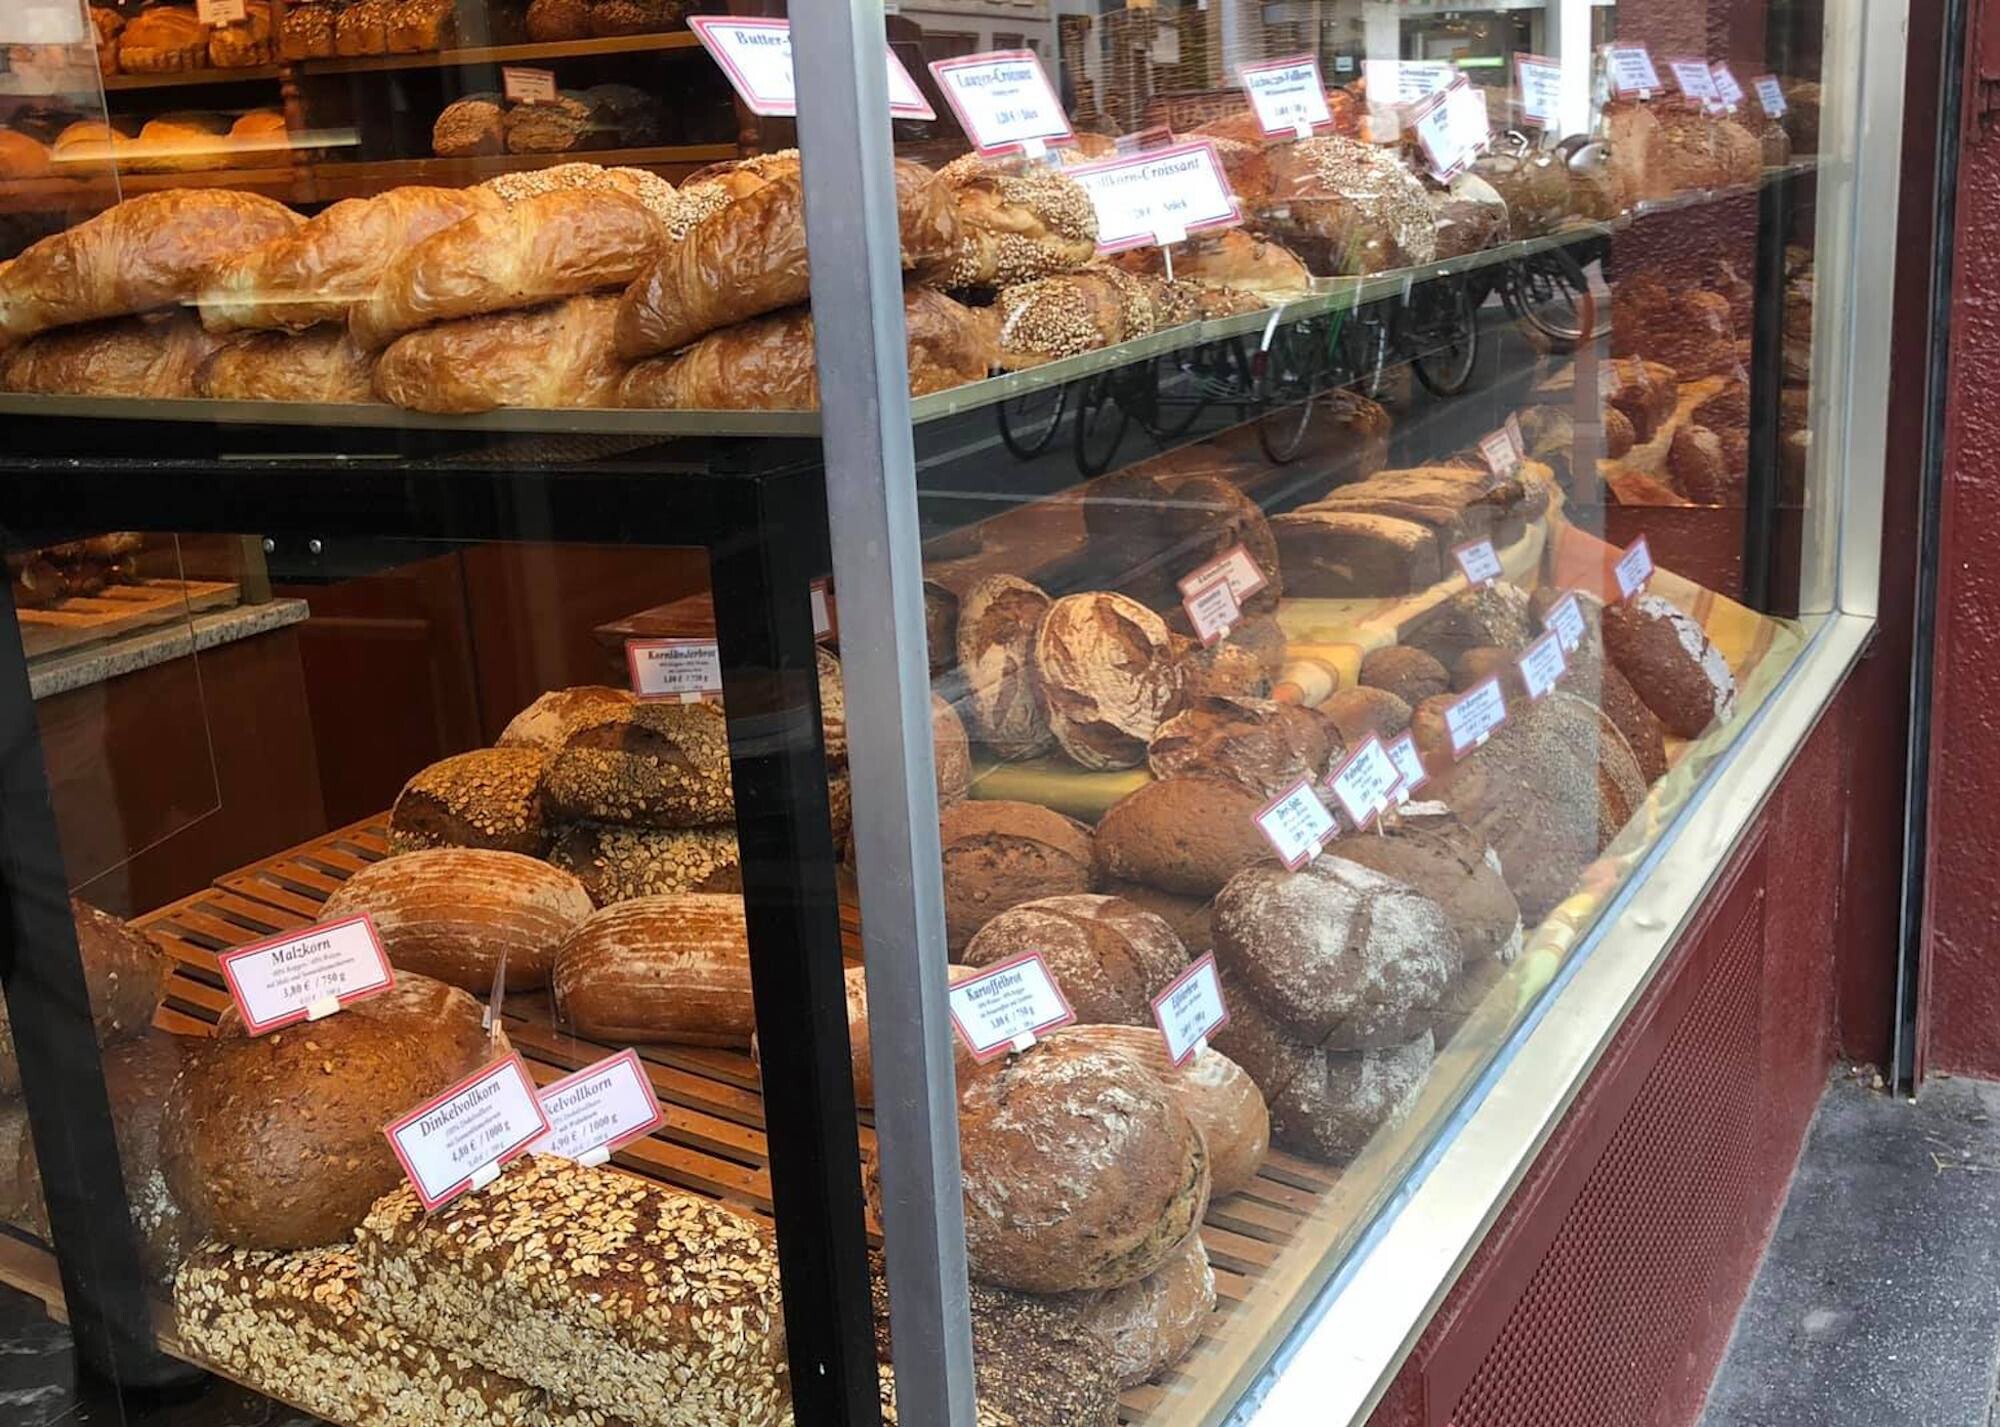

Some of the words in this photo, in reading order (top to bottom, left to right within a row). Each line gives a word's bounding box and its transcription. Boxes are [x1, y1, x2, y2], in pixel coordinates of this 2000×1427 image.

[735, 31, 792, 46] Butter-
[271, 938, 331, 966] Malzkorn
[303, 982, 310, 992] €
[321, 973, 338, 987] 750
[339, 972, 346, 982] g
[965, 972, 1023, 1002] Kartoffelbrot
[417, 1078, 502, 1137] Dinkelvollkorn
[469, 1139, 478, 1150] €
[484, 1122, 504, 1141] 1000
[503, 1120, 512, 1131] g
[570, 1131, 578, 1141] €
[588, 1114, 610, 1132] 1000
[610, 1113, 618, 1123] g
